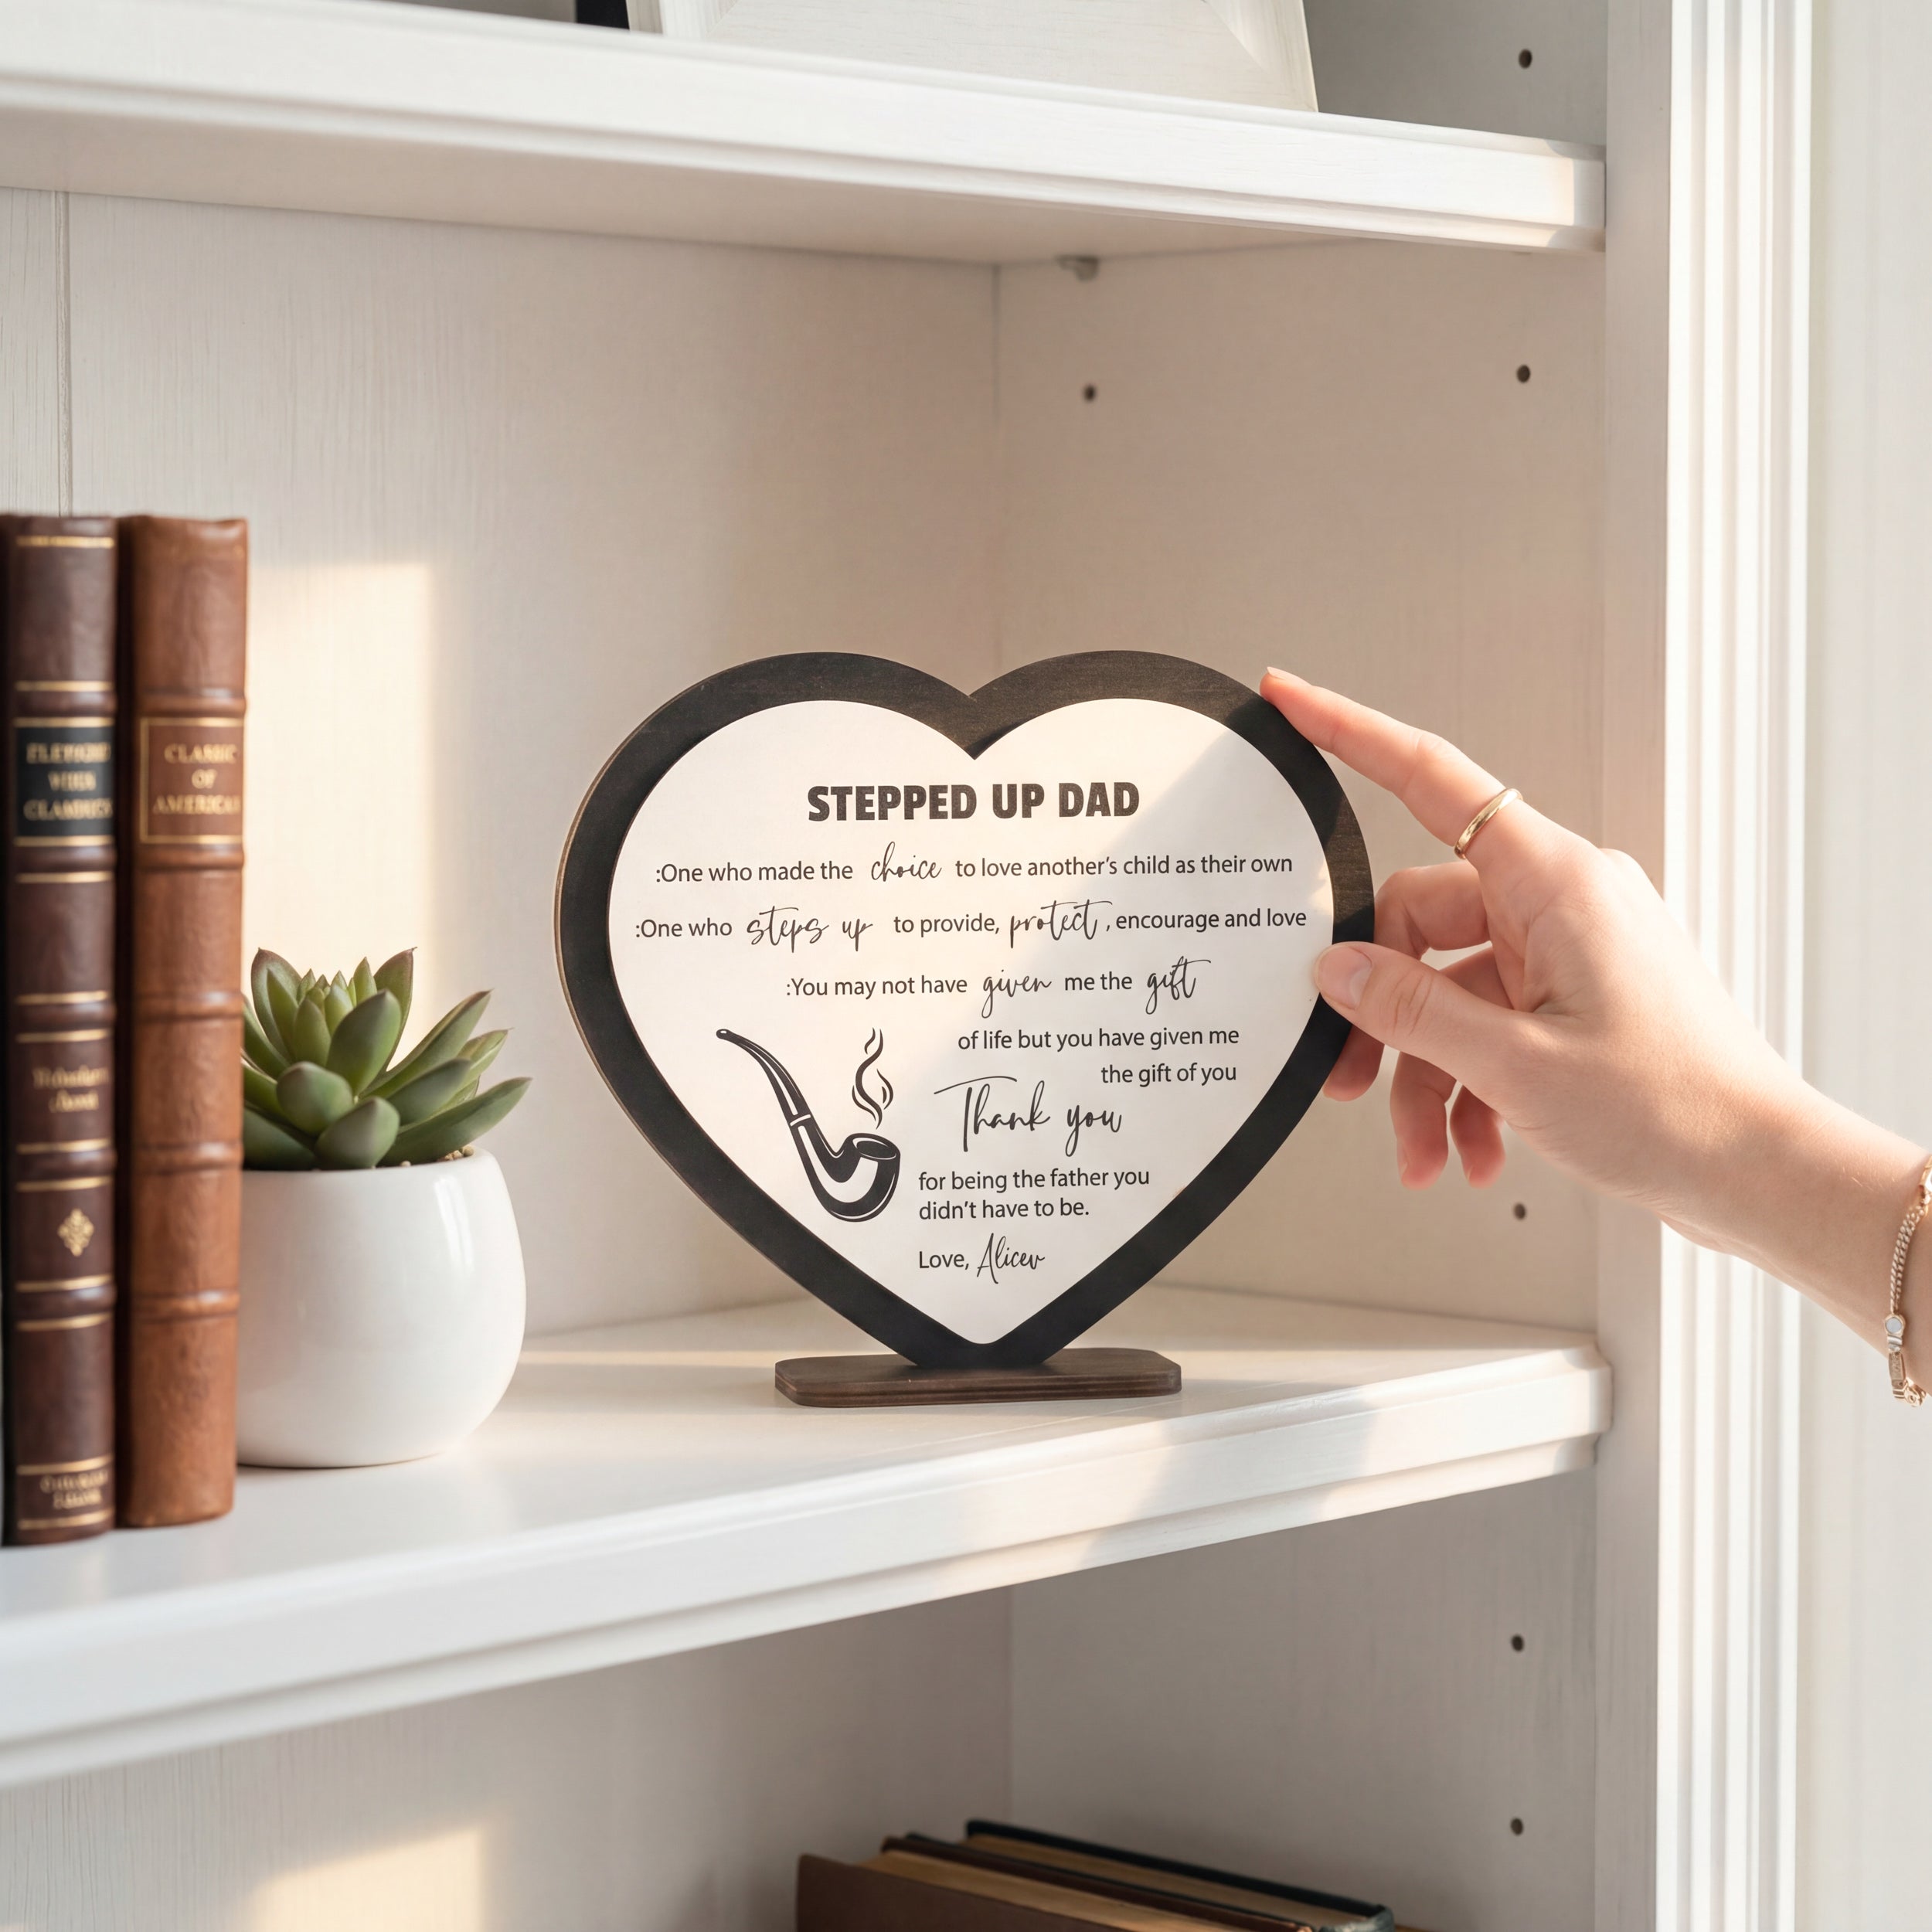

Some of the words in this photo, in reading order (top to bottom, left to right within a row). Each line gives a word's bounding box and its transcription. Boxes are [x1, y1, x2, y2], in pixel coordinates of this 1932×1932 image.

[808, 784, 977, 822] STEPPED
[992, 783, 1046, 819] UP
[1059, 781, 1140, 818] DAD
[708, 862, 753, 883] who
[758, 861, 815, 882] made
[819, 860, 854, 880] the
[870, 841, 943, 883] choice
[954, 859, 976, 878] to
[981, 857, 1022, 878] love
[1123, 854, 1170, 875] child
[1175, 859, 1196, 874] as
[1200, 854, 1247, 874] their
[1250, 858, 1293, 873] own
[688, 917, 733, 938] who
[746, 905, 830, 954] steps
[842, 918, 874, 952] up
[893, 916, 915, 934] to
[920, 912, 1000, 938] provide,
[1224, 907, 1261, 928] and
[1267, 907, 1307, 927] love
[835, 981, 877, 1001] may
[882, 977, 916, 995] not
[921, 975, 968, 994] have
[981, 968, 1053, 1019] given
[1064, 976, 1096, 992] me
[1100, 971, 1133, 991] the
[1145, 955, 1212, 1015] gift
[957, 1029, 980, 1050] of
[983, 1029, 1013, 1049] life
[1018, 1029, 1052, 1049] but
[1056, 1032, 1093, 1053] you
[1098, 1027, 1145, 1047] have
[1149, 1026, 1203, 1051] given
[1209, 1029, 1240, 1045] me
[1100, 1063, 1134, 1084] the
[1138, 1062, 1172, 1088] gift
[1176, 1062, 1198, 1082] of
[1200, 1066, 1236, 1087] you
[933, 1075, 1051, 1153] Thank
[1064, 1104, 1122, 1158] you
[918, 1171, 947, 1191] for
[951, 1170, 1008, 1194] being
[1012, 1168, 1046, 1189] the
[1049, 1167, 1110, 1188] father
[1113, 1170, 1151, 1192] you
[982, 1199, 1029, 1219] have
[1033, 1199, 1055, 1217] to
[1060, 1196, 1090, 1216] be.
[919, 1250, 970, 1270] Love,
